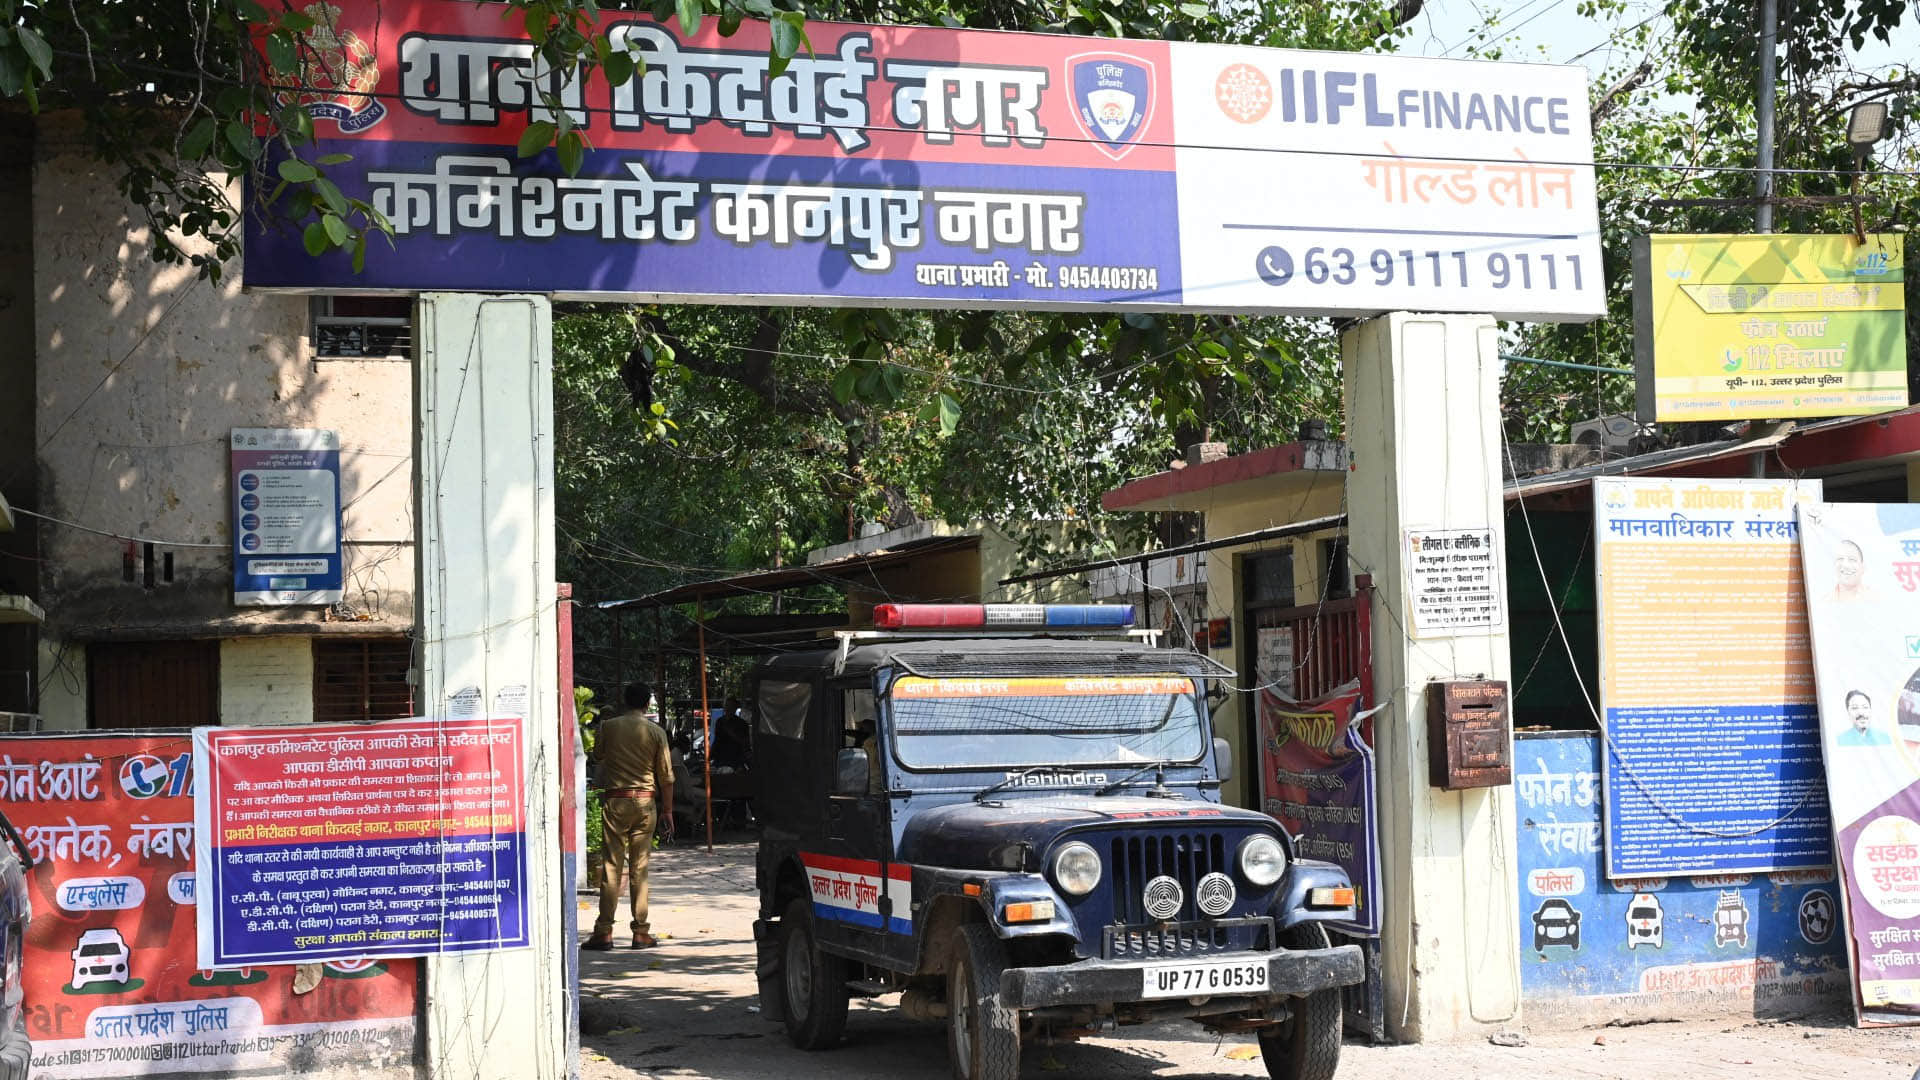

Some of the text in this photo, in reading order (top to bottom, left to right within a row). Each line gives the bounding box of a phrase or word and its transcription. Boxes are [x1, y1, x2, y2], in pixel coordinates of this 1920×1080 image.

[404, 23, 1047, 151] थाना किदवई नगर
[1280, 68, 1570, 135] IIFL FINANCE
[1361, 141, 1575, 209] गोल्ड लोन
[367, 155, 1083, 270] कमिश्नरेट कानपुर नगर
[916, 263, 957, 287] थाना
[960, 262, 1008, 288] प्रभारी
[1024, 264, 1053, 288] मो.
[1058, 266, 1158, 290] 9454403734
[1304, 247, 1583, 291] 63 9111 9111
[1795, 376, 1815, 387] प्रदेश
[1818, 374, 1842, 388] पुलिस
[1609, 512, 1734, 538] मानवाधिकार
[221, 744, 264, 759] कानपुर
[267, 739, 326, 754] कमिश्नरेट
[328, 737, 364, 755] पुलिस
[367, 734, 408, 750] आपकी
[410, 735, 434, 748] सेवा
[449, 732, 478, 746] सदैव
[282, 755, 454, 774] आपका डीसीपी आपका कप्तान
[234, 781, 250, 792] यदि
[285, 779, 308, 789] किसी
[363, 776, 392, 786] समस्या
[395, 776, 404, 784] या
[1518, 758, 1572, 806] फोन
[227, 798, 240, 806] पर
[272, 811, 302, 820] समस्या
[224, 824, 254, 842] प्रभारी
[256, 824, 298, 840] निरीक्षक
[300, 824, 323, 838] थाना
[326, 819, 362, 836] किदवई
[394, 820, 430, 835] कानपुर
[464, 814, 512, 828] 945443734
[24, 816, 122, 869] अनेक,
[228, 851, 243, 864] यदि
[245, 852, 262, 864] थाना
[264, 852, 280, 862] स्तर
[282, 849, 289, 862] से
[290, 848, 302, 861] की
[304, 847, 320, 860] गयी
[322, 846, 354, 860] कार्यवाही
[356, 845, 364, 858] से
[365, 847, 380, 858] आप
[382, 846, 408, 860] सन्तुष्ट
[425, 842, 431, 856] है
[432, 843, 440, 854] तो
[1864, 844, 1918, 864] सड़क
[252, 870, 261, 883] के
[263, 872, 284, 882] समक्ष
[286, 870, 309, 884] प्रस्तुत
[310, 867, 318, 880] हो
[320, 868, 334, 879] कर
[335, 864, 357, 878] अपनी
[359, 866, 386, 877] समस्या
[388, 865, 398, 876] का
[400, 862, 434, 876] निराकरण
[452, 859, 474, 872] सकते
[1534, 871, 1575, 892] पुलिस
[232, 891, 274, 904] ए.सी.पी.
[332, 886, 368, 898] गोविन्द
[399, 884, 434, 896] कानपुर
[812, 873, 878, 909] उत्तर प्रदेश पुलिस
[340, 902, 366, 912] पराग
[389, 899, 424, 910] कानपुर
[248, 920, 292, 932] डी.सी.पी.
[336, 917, 361, 926] पराग
[384, 913, 420, 925] कानपुर
[294, 929, 406, 948] सुरक्षा आपकी संकल्प
[1869, 926, 1910, 948] सुरक्षित
[1872, 949, 1914, 972] सुरक्षित
[1158, 966, 1266, 990] UP 77 G 0539
[95, 1014, 132, 1039] उत्तर
[136, 1008, 175, 1038] प्रदेश
[184, 1004, 228, 1034] पुलिस
